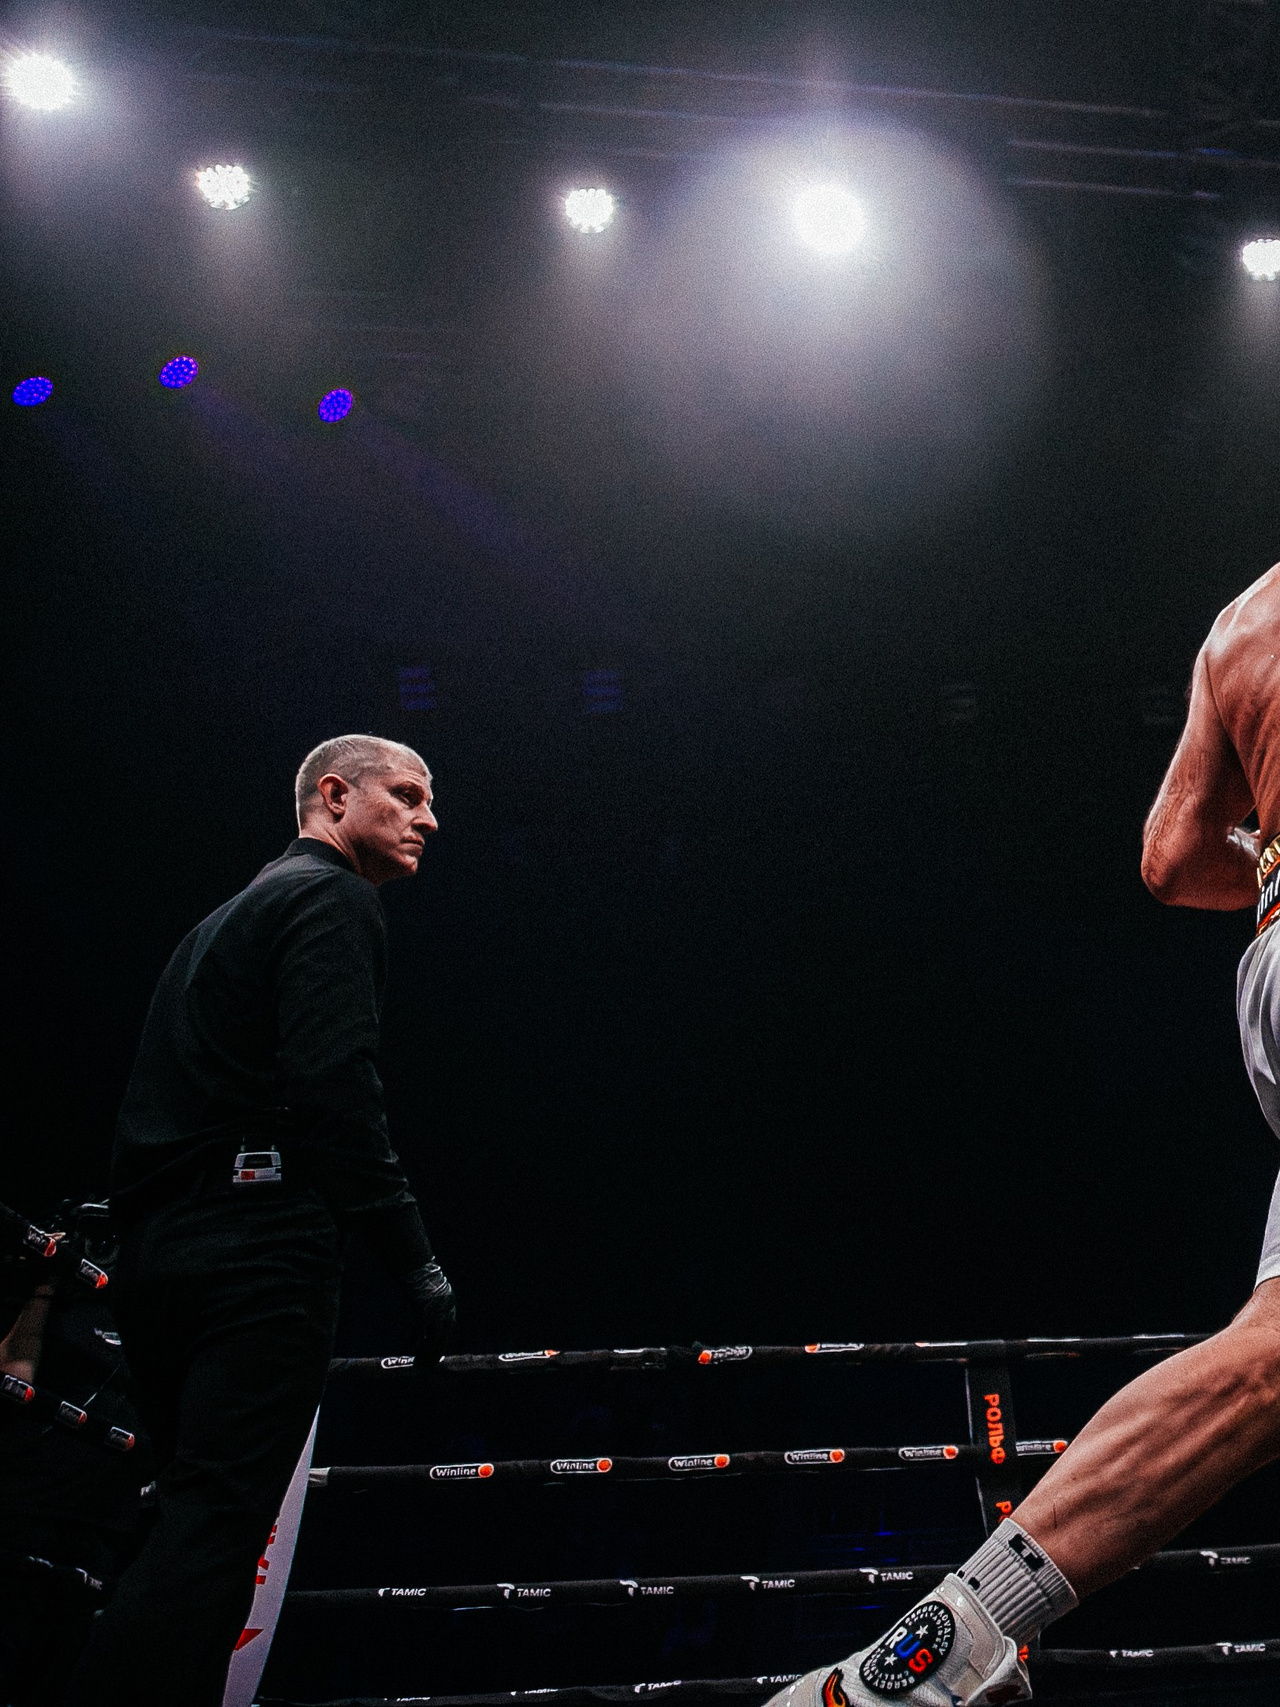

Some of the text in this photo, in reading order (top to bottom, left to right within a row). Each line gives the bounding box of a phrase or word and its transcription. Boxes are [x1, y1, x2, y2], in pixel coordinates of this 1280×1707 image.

[791, 1451, 829, 1462] Winline
[904, 1448, 942, 1458] Winline
[556, 1461, 595, 1471] Winline
[673, 1457, 713, 1468] Winline
[436, 1466, 476, 1477] Winline
[880, 1572, 914, 1581] TAMIC
[761, 1579, 796, 1589] TAMIC
[391, 1588, 427, 1596] TAMIC
[516, 1589, 551, 1597] TAMIC
[641, 1586, 675, 1595] TAMIC
[885, 1626, 934, 1673] RUS
